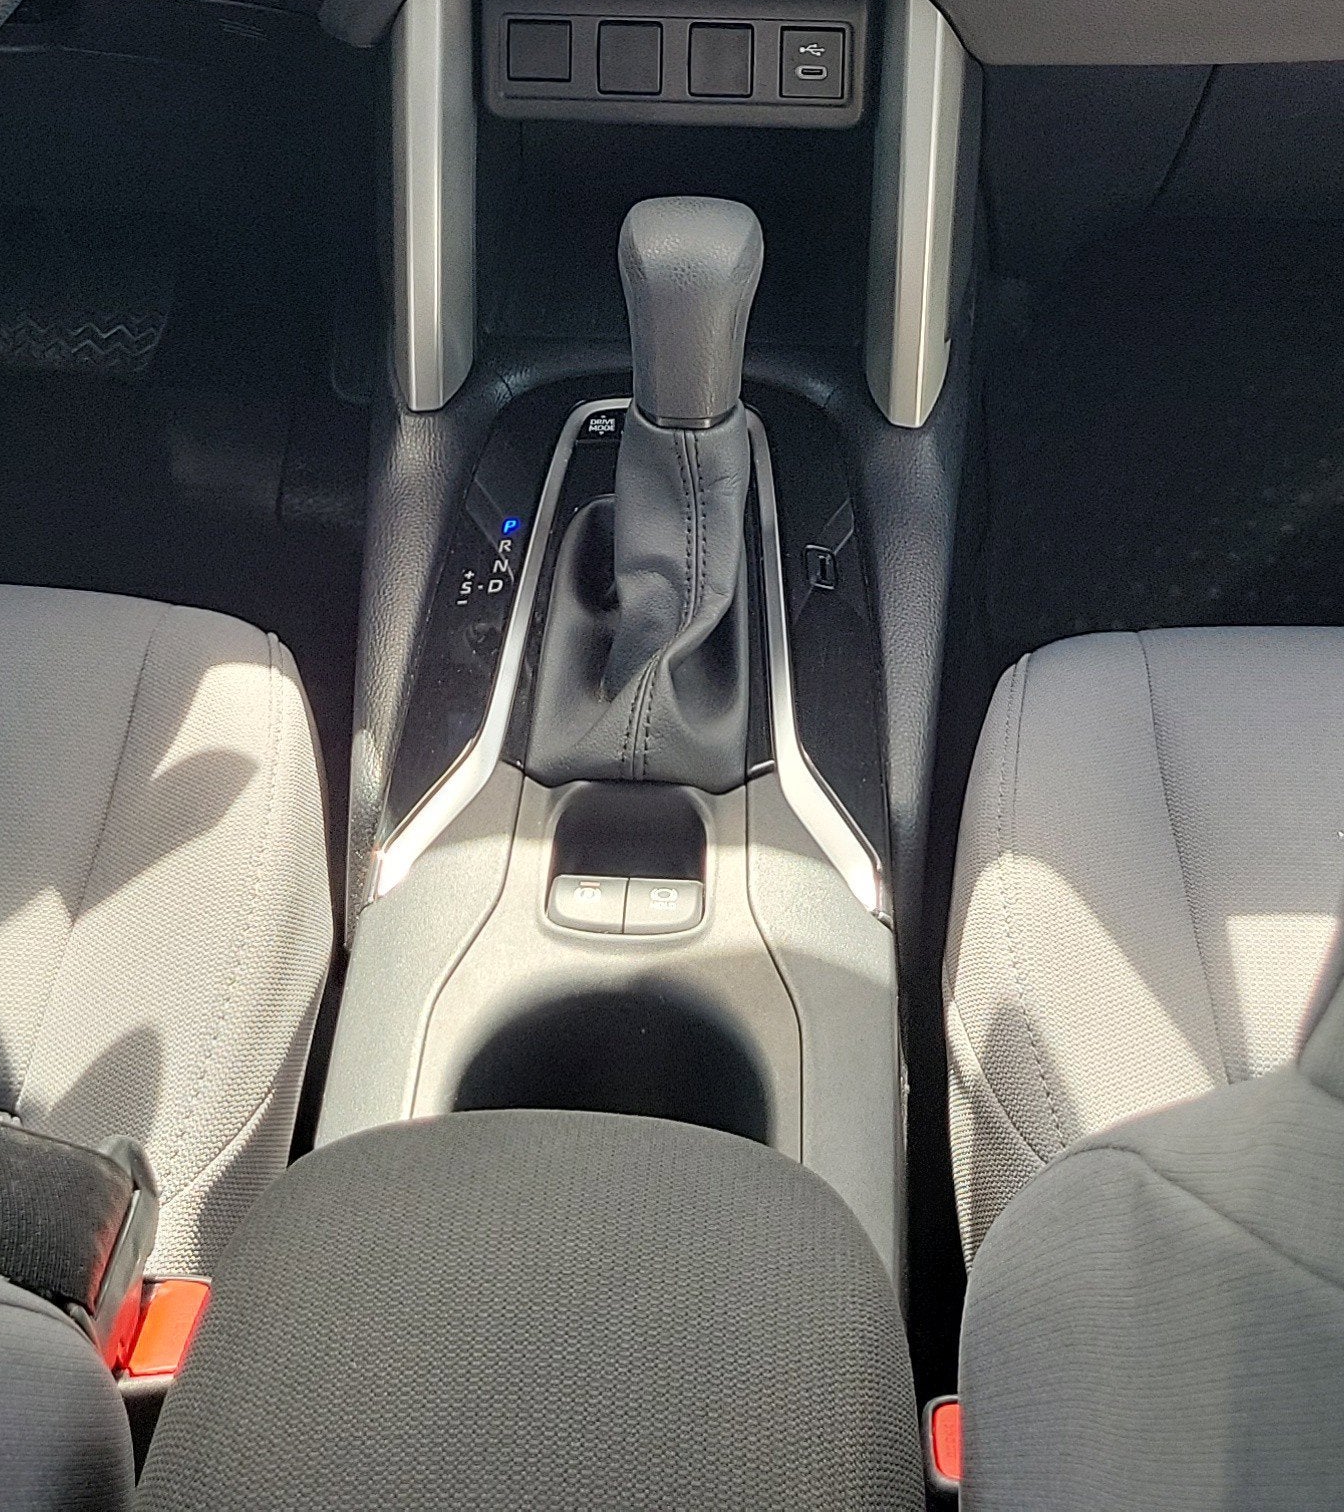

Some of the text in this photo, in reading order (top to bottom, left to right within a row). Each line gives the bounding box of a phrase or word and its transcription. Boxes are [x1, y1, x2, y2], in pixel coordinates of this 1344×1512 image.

[588, 424, 616, 432] MODE
[503, 519, 517, 533] P
[498, 539, 512, 553] R
[492, 559, 509, 573] N
[459, 579, 504, 595] S D
